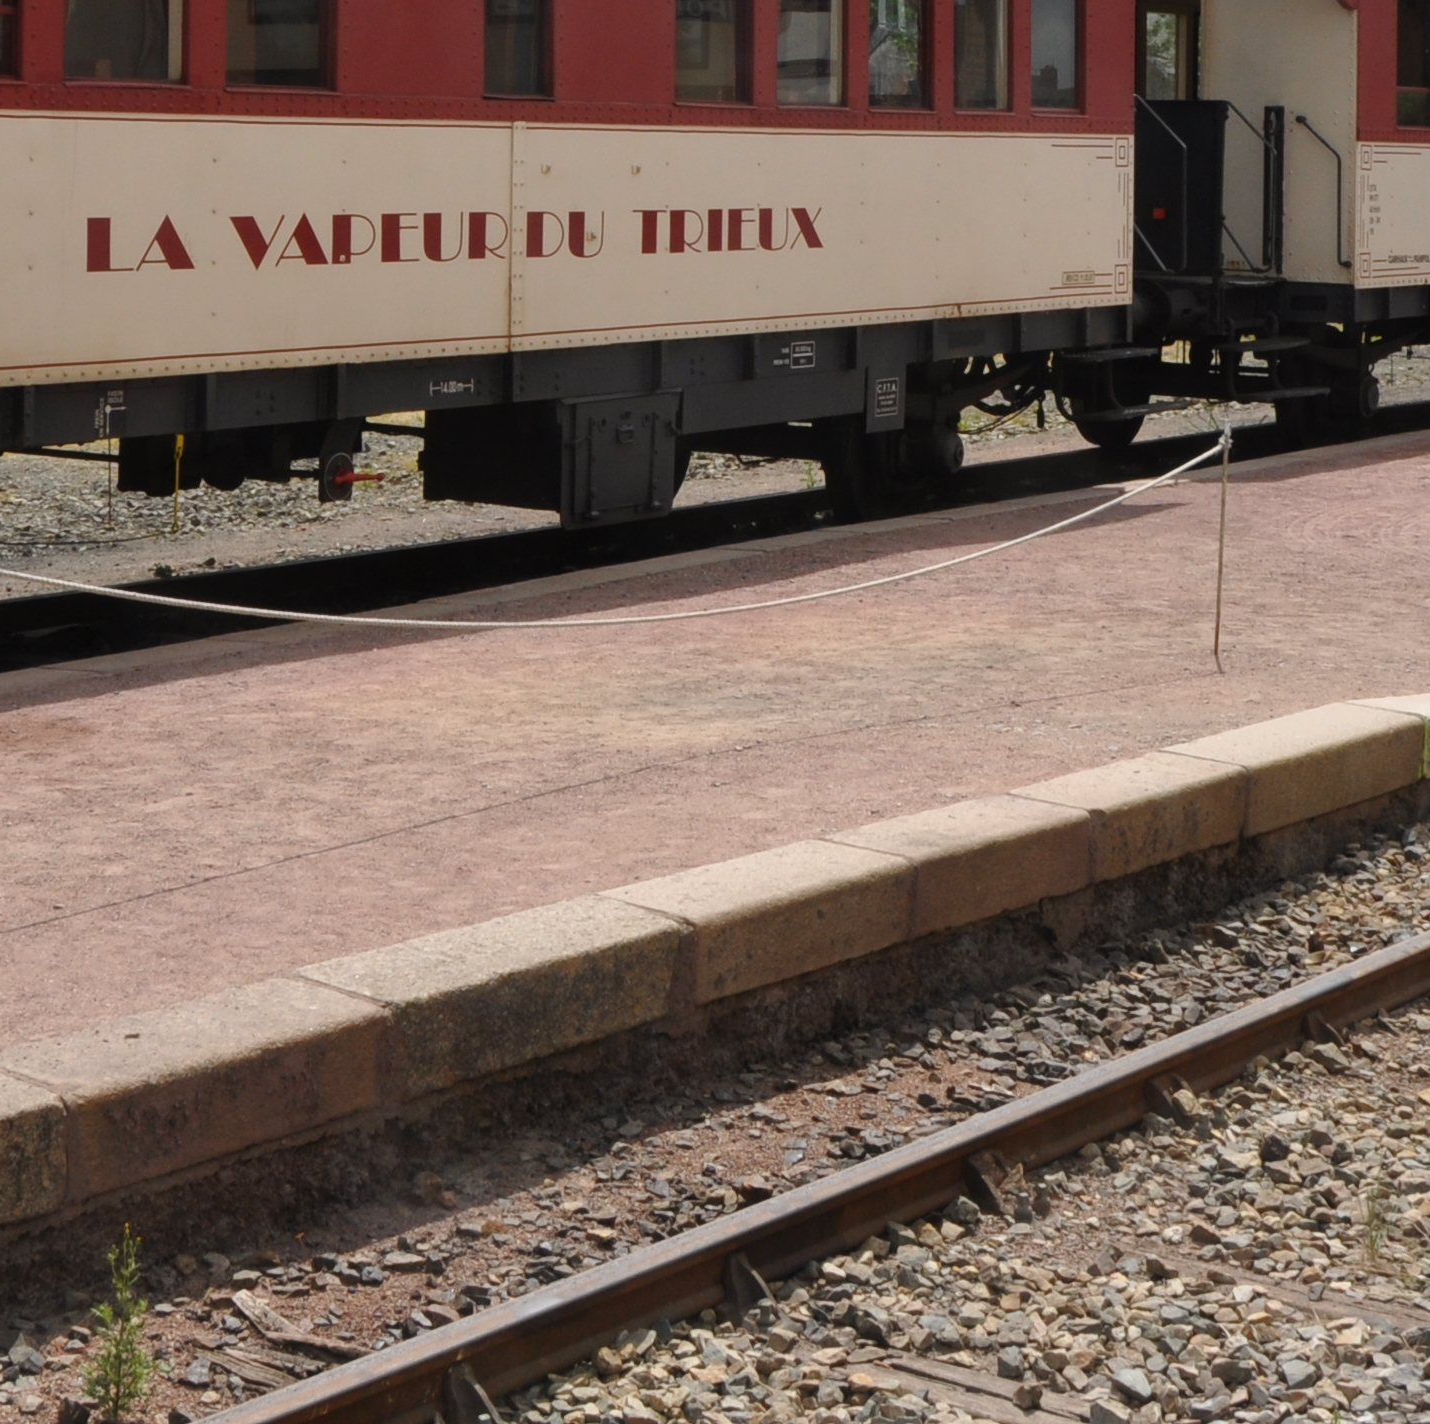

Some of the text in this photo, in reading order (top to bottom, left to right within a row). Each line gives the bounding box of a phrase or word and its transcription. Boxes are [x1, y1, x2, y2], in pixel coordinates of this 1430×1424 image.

[86, 207, 824, 273] LA VAPEUR DU TRIEUX
